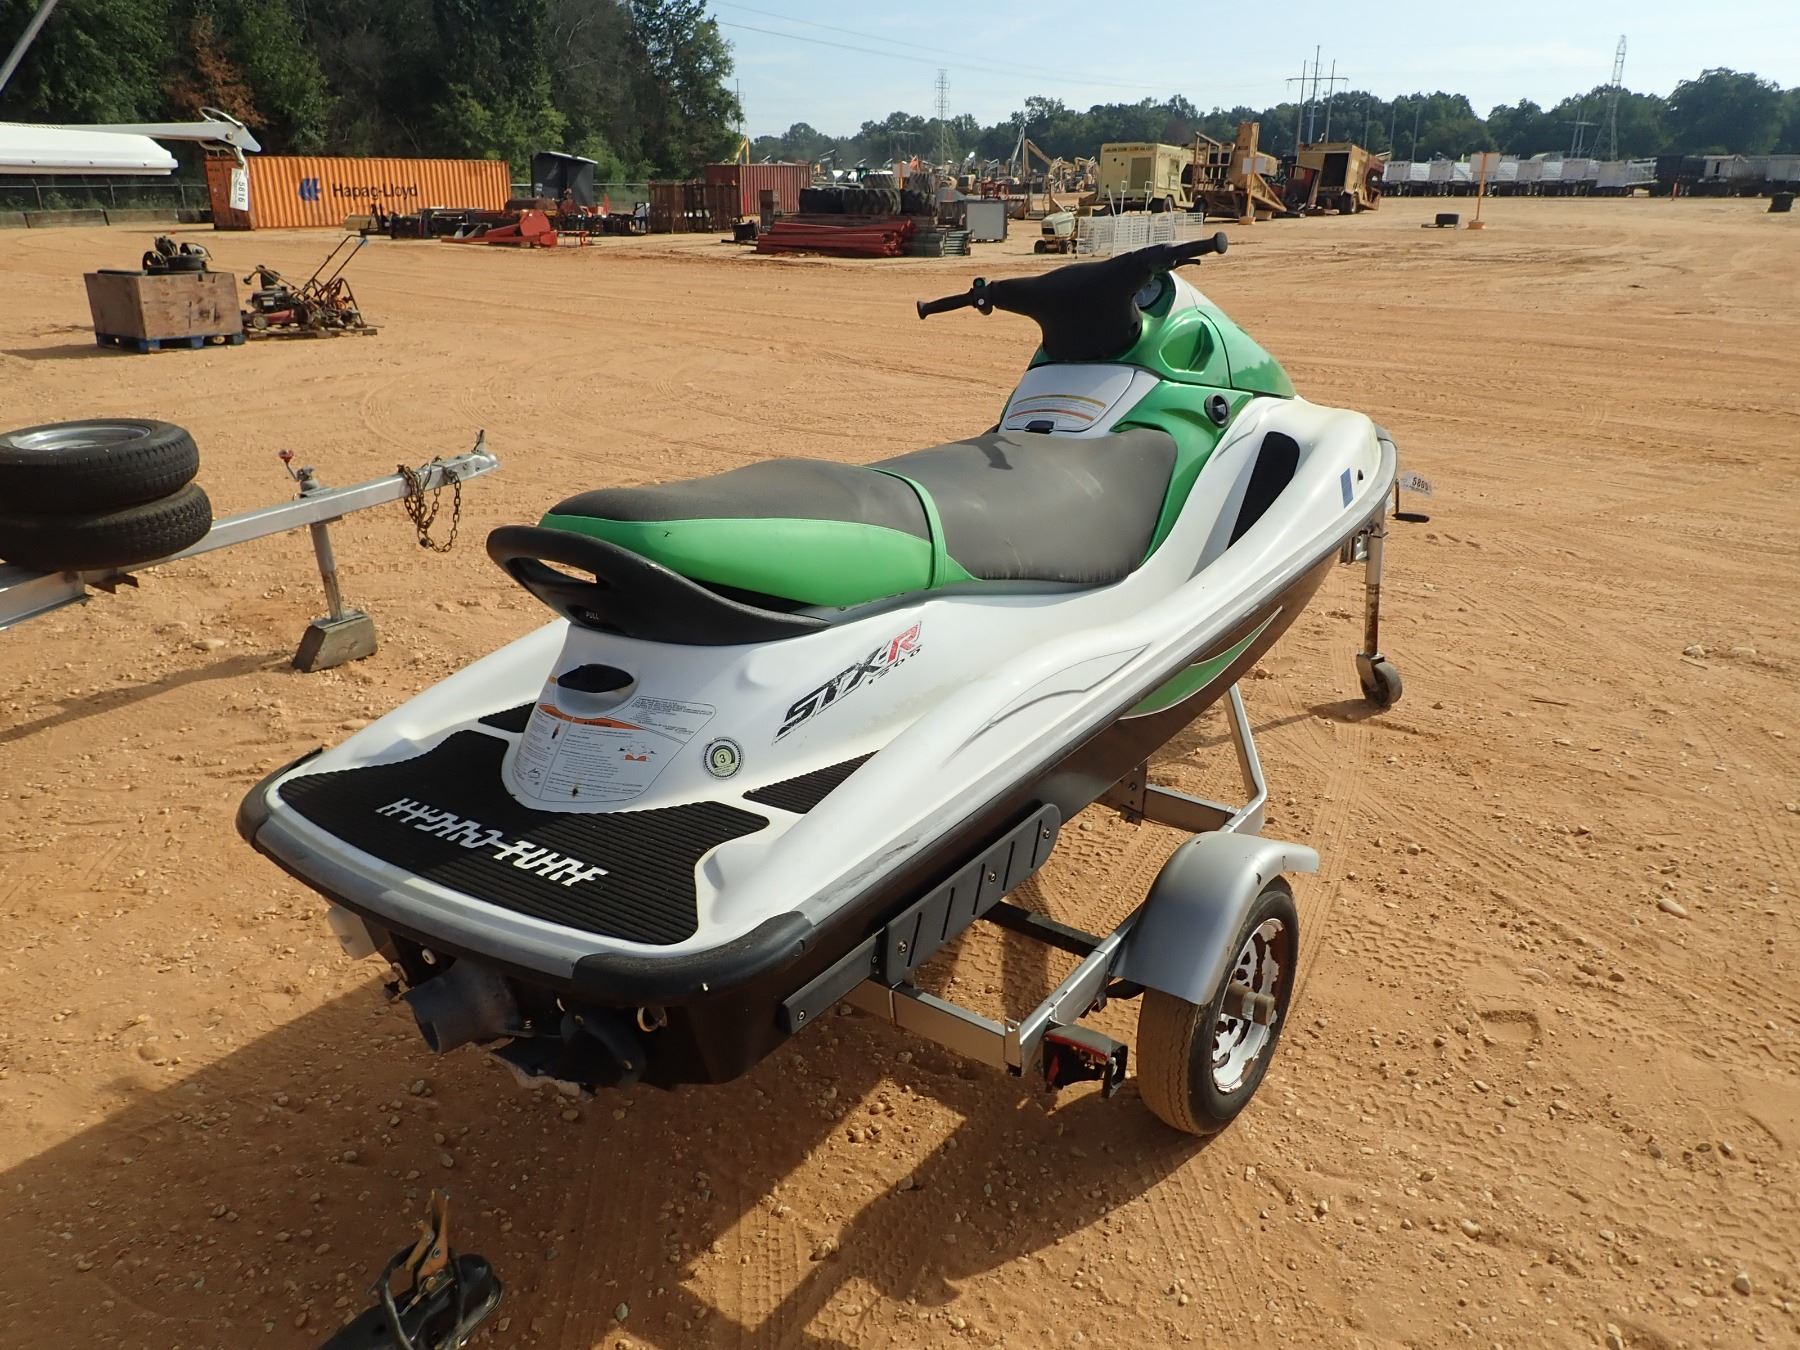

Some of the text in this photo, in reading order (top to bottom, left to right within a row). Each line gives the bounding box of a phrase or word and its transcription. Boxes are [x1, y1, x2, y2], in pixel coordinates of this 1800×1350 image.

[332, 183, 418, 200] Hapag-Lloyd
[719, 753, 726, 764] 3
[375, 797, 608, 887] HYDRO-TURF
